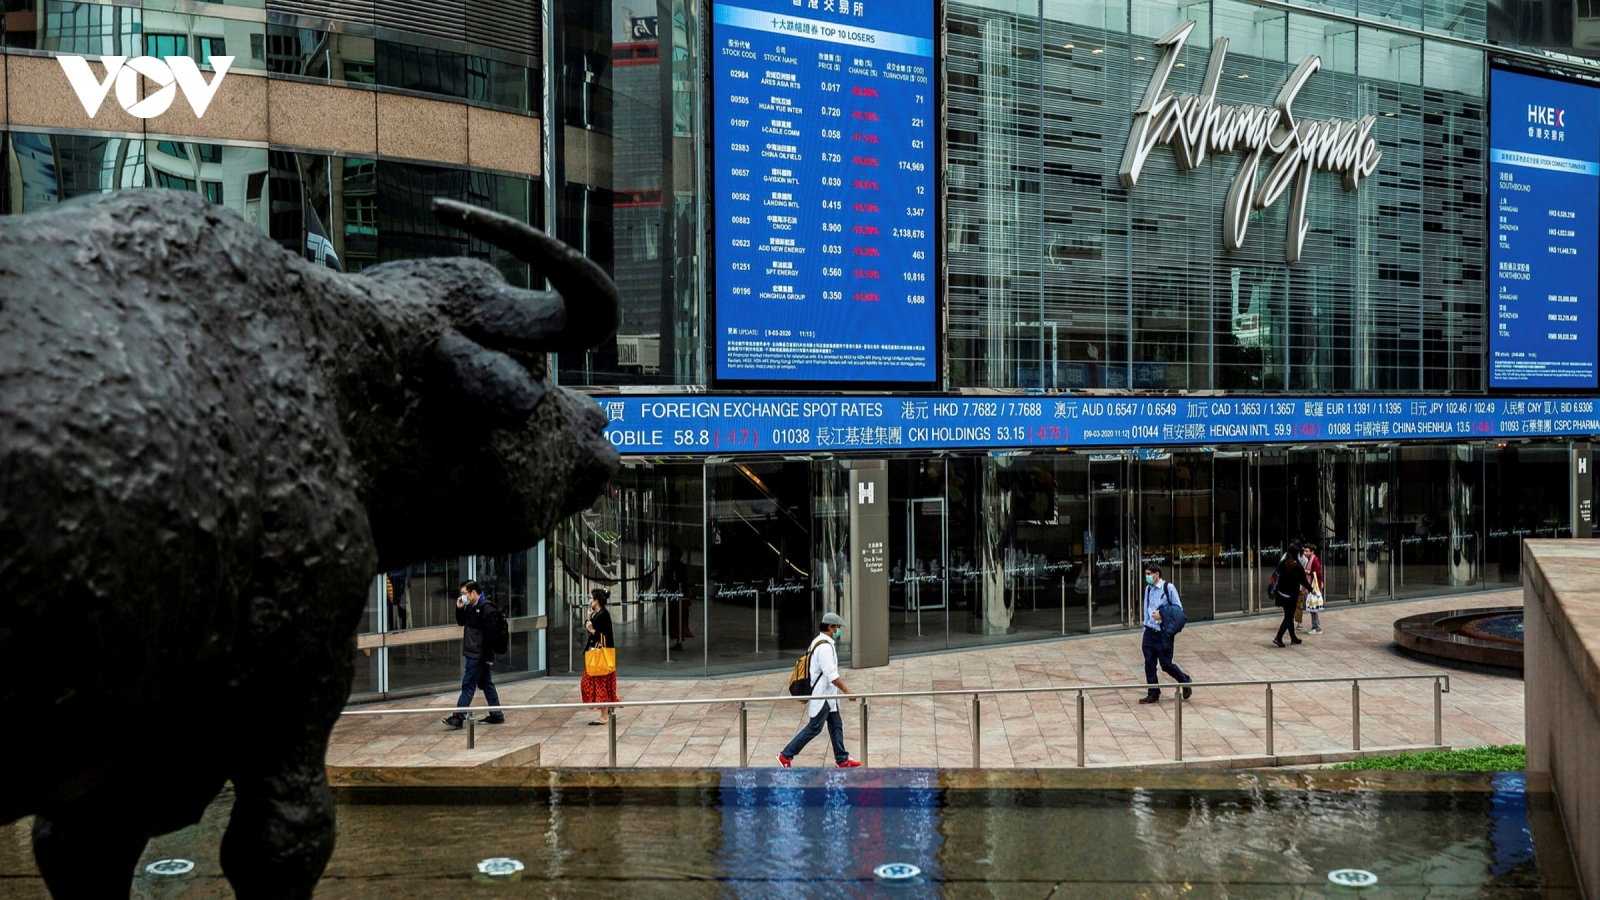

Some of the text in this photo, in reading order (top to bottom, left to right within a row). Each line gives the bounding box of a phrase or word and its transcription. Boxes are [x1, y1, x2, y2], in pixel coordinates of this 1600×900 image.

[771, 18, 875, 43] 十大跌幅證券 TOP 10 LOSERS
[722, 48, 756, 59] STOCK CODE
[764, 54, 797, 65] STOCK NAME
[818, 62, 832, 70] PRICE
[730, 69, 749, 79] 02984
[848, 67, 869, 76] CHANGE
[883, 71, 909, 81] TURNOVER
[821, 82, 840, 92] 0.017
[916, 94, 924, 103] 71
[787, 106, 802, 114] INTER
[822, 106, 840, 117] 0.720
[1528, 104, 1564, 127] HKEX
[731, 119, 749, 128] 01097
[912, 118, 924, 127] 221
[762, 126, 800, 137] I-CABLE COMM
[822, 129, 841, 139] 0.058
[1528, 126, 1564, 141] 香港交易所
[912, 140, 924, 149] 621
[1118, 19, 1293, 249] Exchange
[1252, 55, 1382, 265] Square
[731, 143, 749, 152] 02883
[779, 152, 802, 161] OILFIELD
[822, 153, 841, 163] 8.720
[899, 161, 924, 172] 174,969
[731, 168, 750, 177] 00657
[763, 175, 786, 183] G-VISION
[822, 177, 841, 186] 0.030
[916, 186, 924, 194] 12
[1500, 182, 1530, 192] SOUTHBOUND
[732, 192, 750, 201] 00582
[822, 200, 841, 210] 0.415
[907, 207, 924, 217] 3,347
[732, 216, 750, 224] 00883
[822, 222, 841, 232] 8.900
[893, 228, 924, 238] 2,138,676
[732, 239, 750, 247] 02623
[823, 244, 842, 254] 0.033
[913, 251, 925, 260] 463
[823, 267, 842, 277] 0.560
[904, 272, 925, 282] 10,816
[1499, 272, 1530, 280] NORTHBOUND
[732, 287, 751, 295] 00196
[823, 291, 842, 300] 0.350
[907, 295, 925, 304] 6,688
[641, 402, 720, 418] FOREIGN
[724, 402, 799, 417] EXCHANGE
[803, 402, 838, 417] SPOT
[841, 403, 882, 417] RATES
[901, 401, 929, 420] 港元
[934, 403, 958, 417] HKD
[963, 403, 997, 417] 7.7682
[1009, 403, 1042, 417] 7.7688
[1054, 401, 1078, 419] 澳元
[1082, 403, 1104, 416] AUD
[1107, 403, 1137, 416] 0.6547
[1147, 403, 1176, 416] 0.6549
[1187, 402, 1208, 419] 加元
[1212, 403, 1231, 415] CAD
[1234, 403, 1261, 415] 1.3653
[1270, 403, 1296, 415] 1.3657
[1304, 402, 1323, 417] 歐羅
[1327, 403, 1344, 414] EUR
[1347, 403, 1370, 414] 1.1391
[1379, 403, 1401, 414] 1.1395
[1411, 402, 1427, 416] 日元
[1429, 402, 1443, 414] JPY
[1446, 402, 1467, 413] 102.46
[1474, 402, 1495, 413] 102.49
[1502, 401, 1525, 415] 人民幣
[1528, 403, 1541, 412] CNY
[1561, 402, 1571, 412] BID
[1574, 402, 1593, 412] 6.9306
[674, 430, 709, 445] 58.8
[773, 429, 810, 444] 01038
[816, 426, 902, 446] 長江基建集團
[908, 427, 929, 441] CKI
[932, 427, 990, 441] HOLDINGS
[997, 427, 1024, 441] 53.15
[1132, 425, 1158, 438] 01044
[1163, 423, 1205, 440] 恒安國際
[1210, 425, 1248, 437] HENGAN
[1250, 424, 1269, 436] INT'L
[1274, 424, 1292, 436] 59.9
[1328, 424, 1350, 434] 01088
[1354, 421, 1389, 436] 中國神華
[1393, 422, 1416, 433] CHINA
[1417, 422, 1452, 433] SHENHUA
[1457, 422, 1470, 432] 13.5
[1501, 421, 1519, 432] 01093
[1554, 420, 1571, 430] CSPC
[1573, 420, 1600, 430] PHARMA
